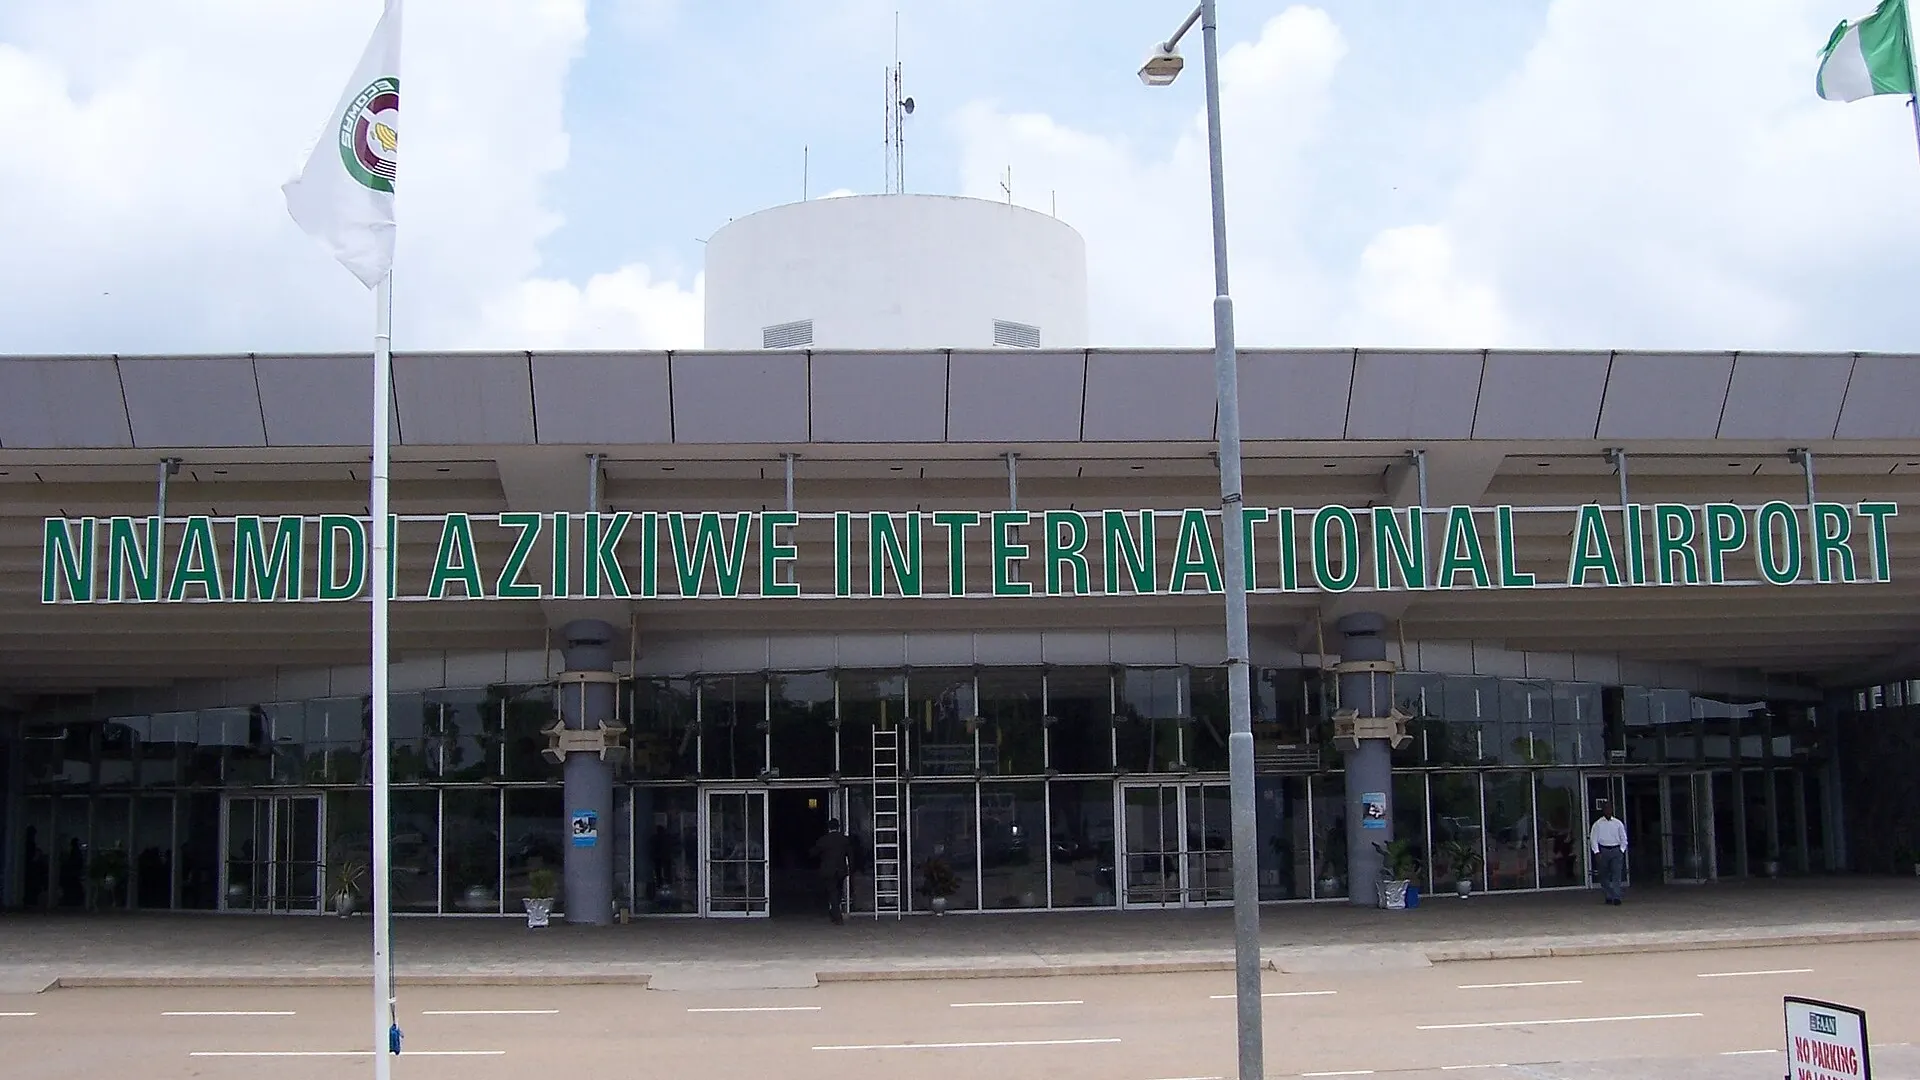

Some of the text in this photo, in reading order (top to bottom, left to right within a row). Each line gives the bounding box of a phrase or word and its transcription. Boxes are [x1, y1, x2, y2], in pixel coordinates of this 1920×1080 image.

[427, 511, 800, 599] AZIKIWE
[834, 505, 1536, 598] INTERNATIONAL
[1569, 501, 1898, 588] AIRPORT
[1795, 1036, 1858, 1076] NO PARKING
